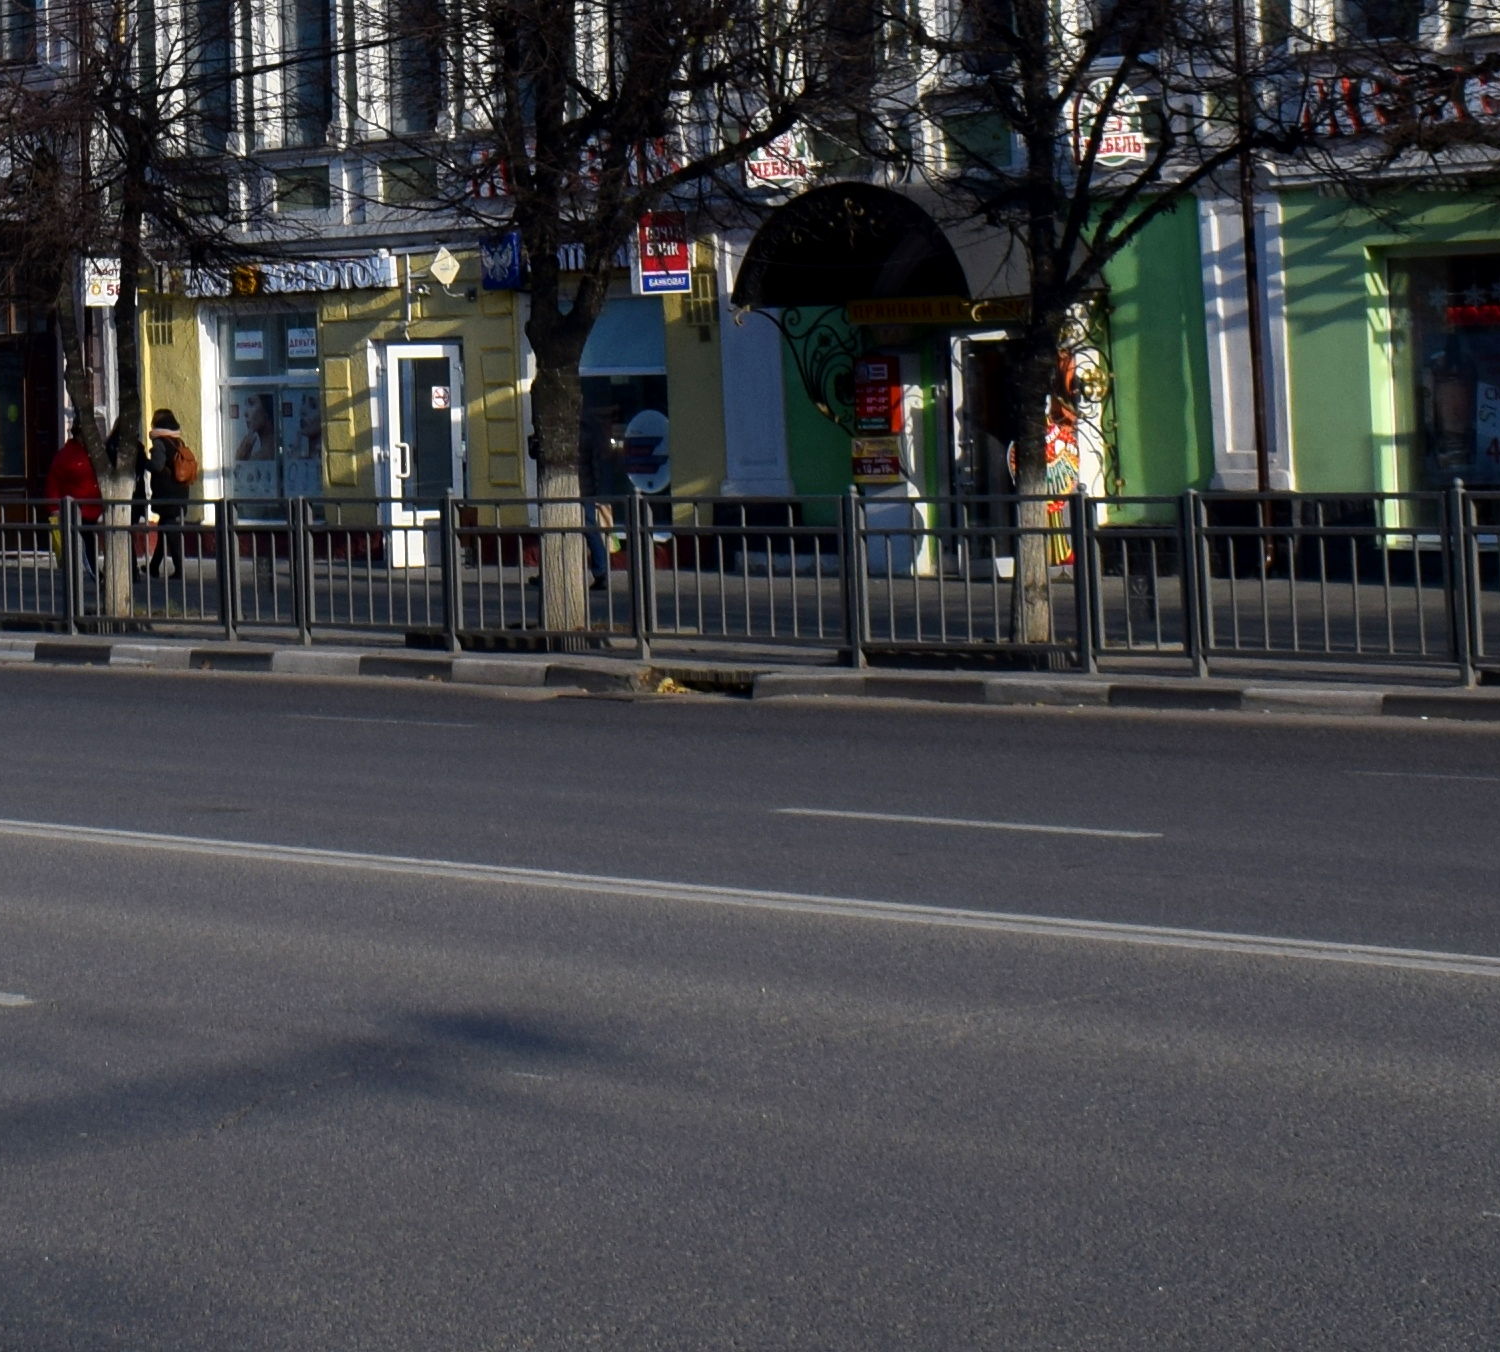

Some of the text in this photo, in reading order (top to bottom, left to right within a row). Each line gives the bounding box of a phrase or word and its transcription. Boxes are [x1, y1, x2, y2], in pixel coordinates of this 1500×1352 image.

[648, 276, 687, 288] БАНКОМАТ
[852, 302, 933, 321] ПРЯНИКИ
[288, 338, 316, 348] ДЕНЬГИ
